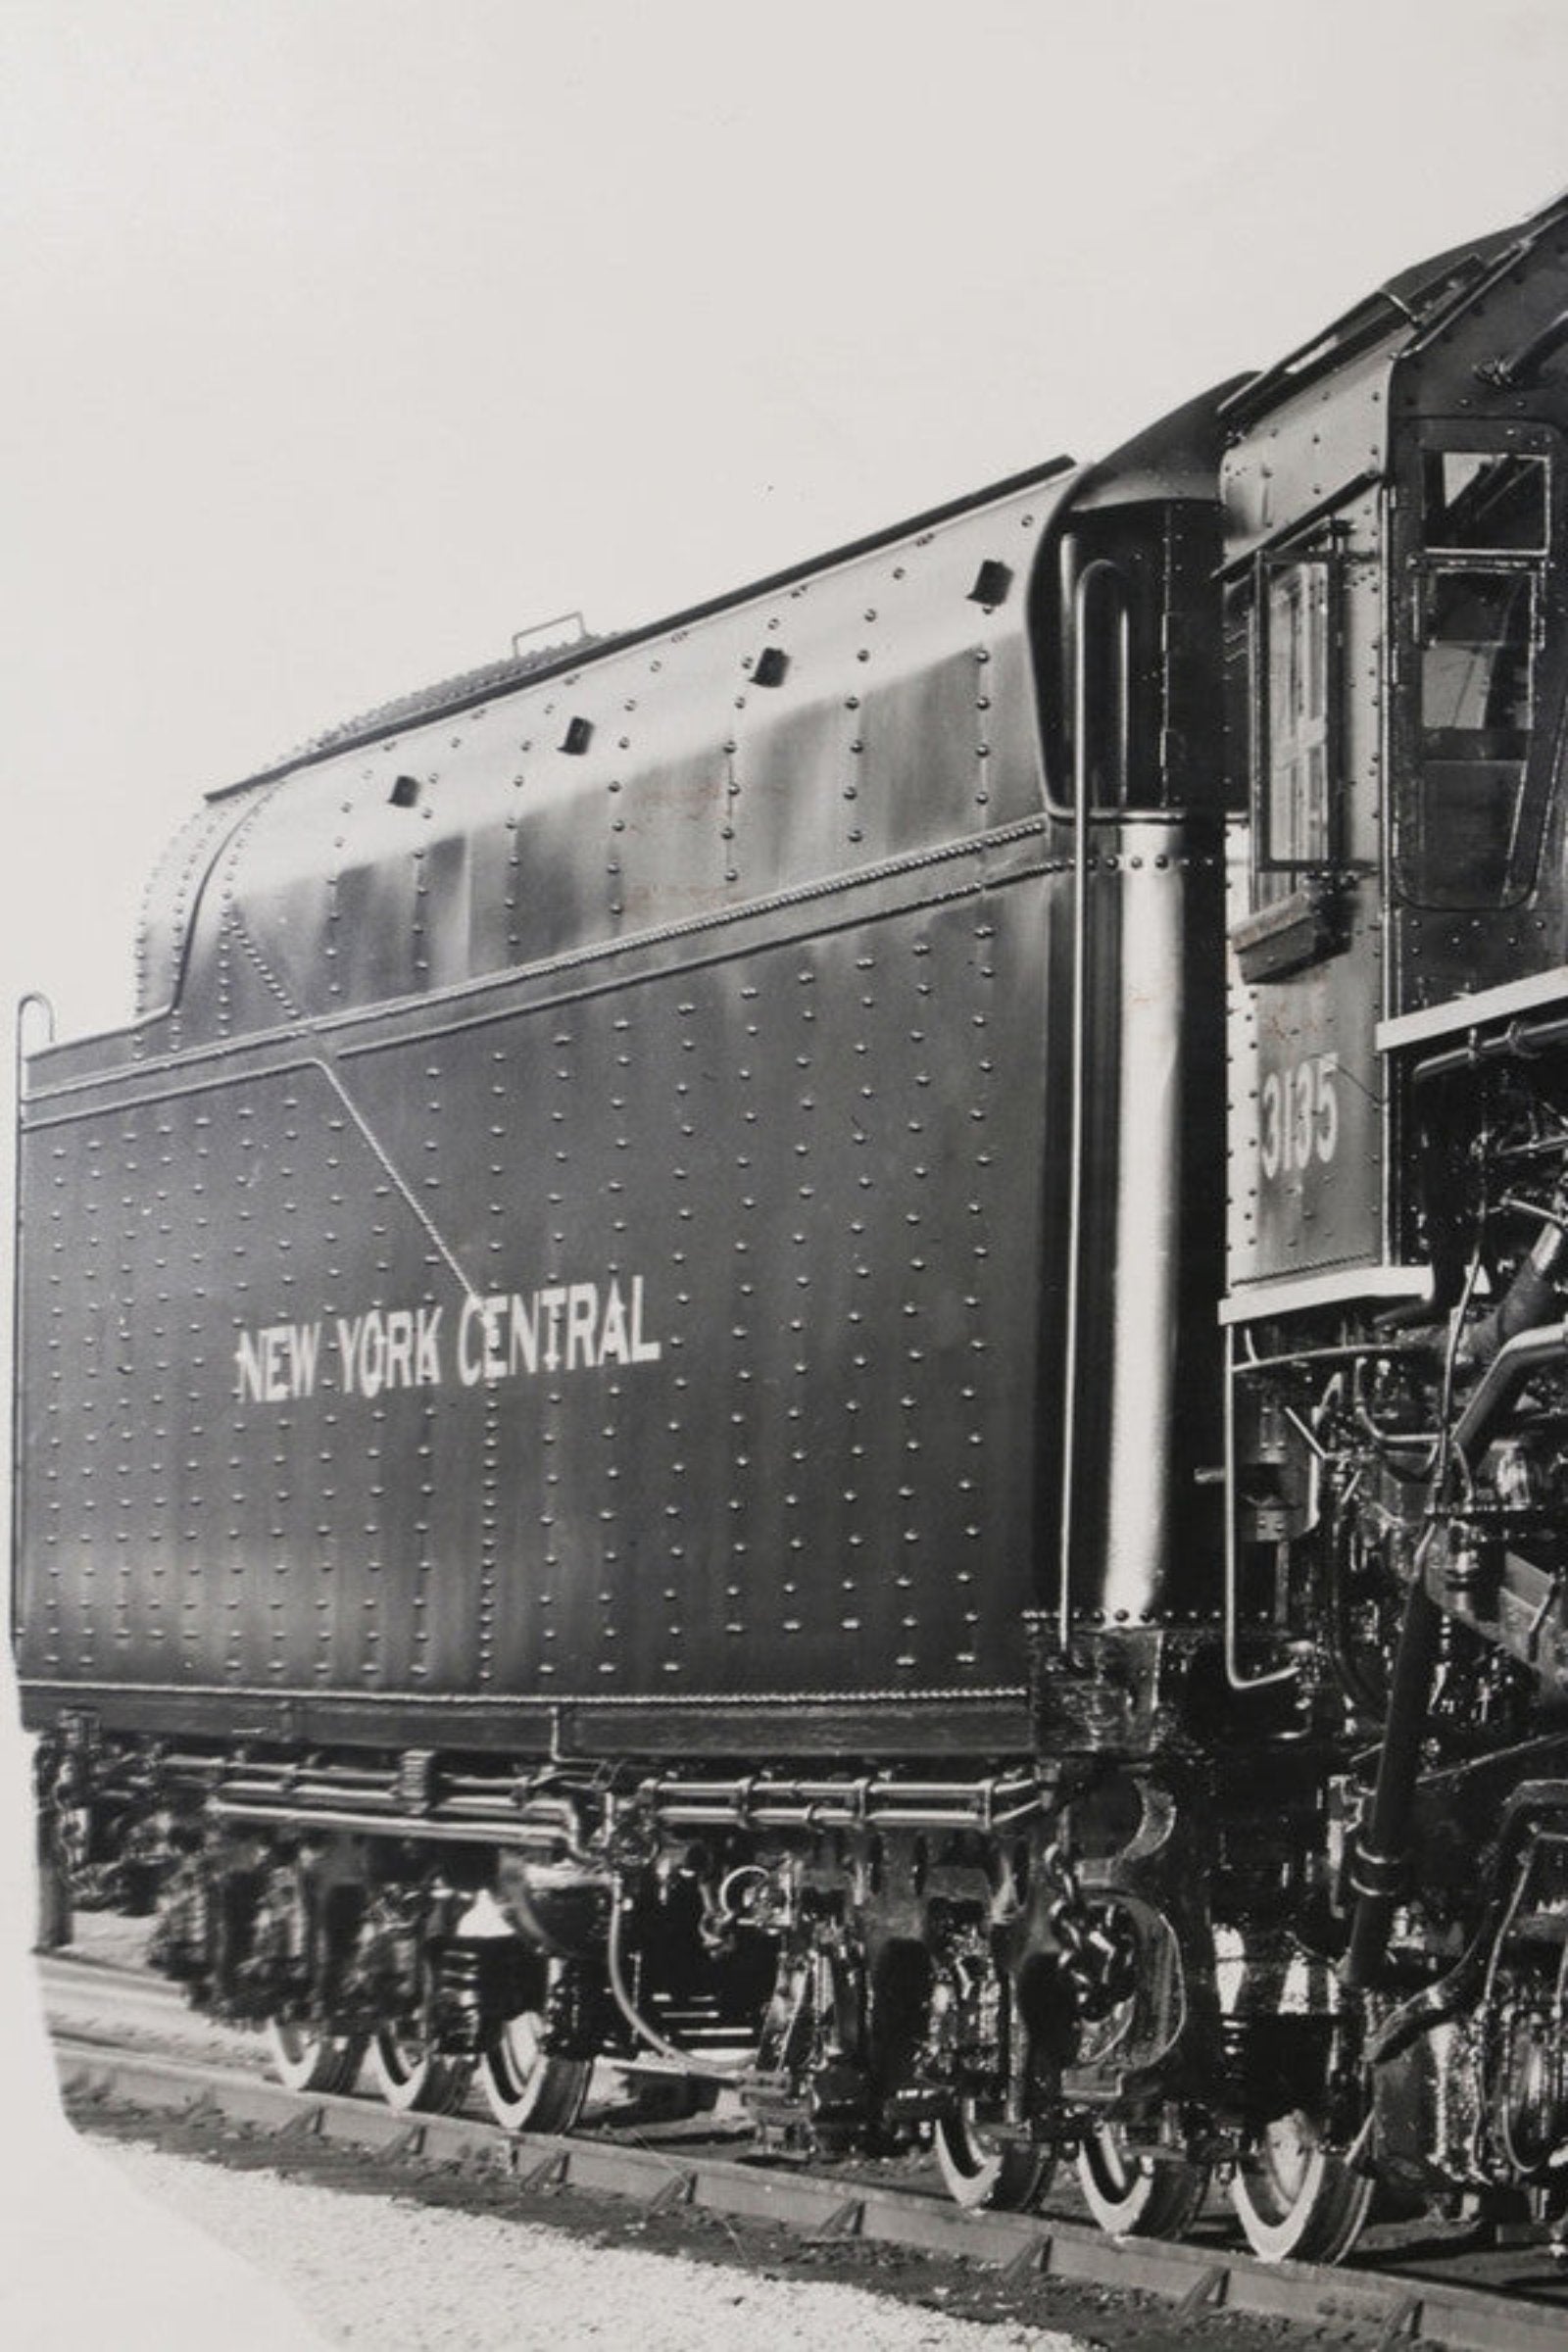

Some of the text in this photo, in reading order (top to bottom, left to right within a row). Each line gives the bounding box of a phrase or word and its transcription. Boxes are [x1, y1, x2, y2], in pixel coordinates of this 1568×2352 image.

[1261, 1052, 1339, 1179] 3135
[236, 1275, 662, 1404] NEW YORK CENTRAL
